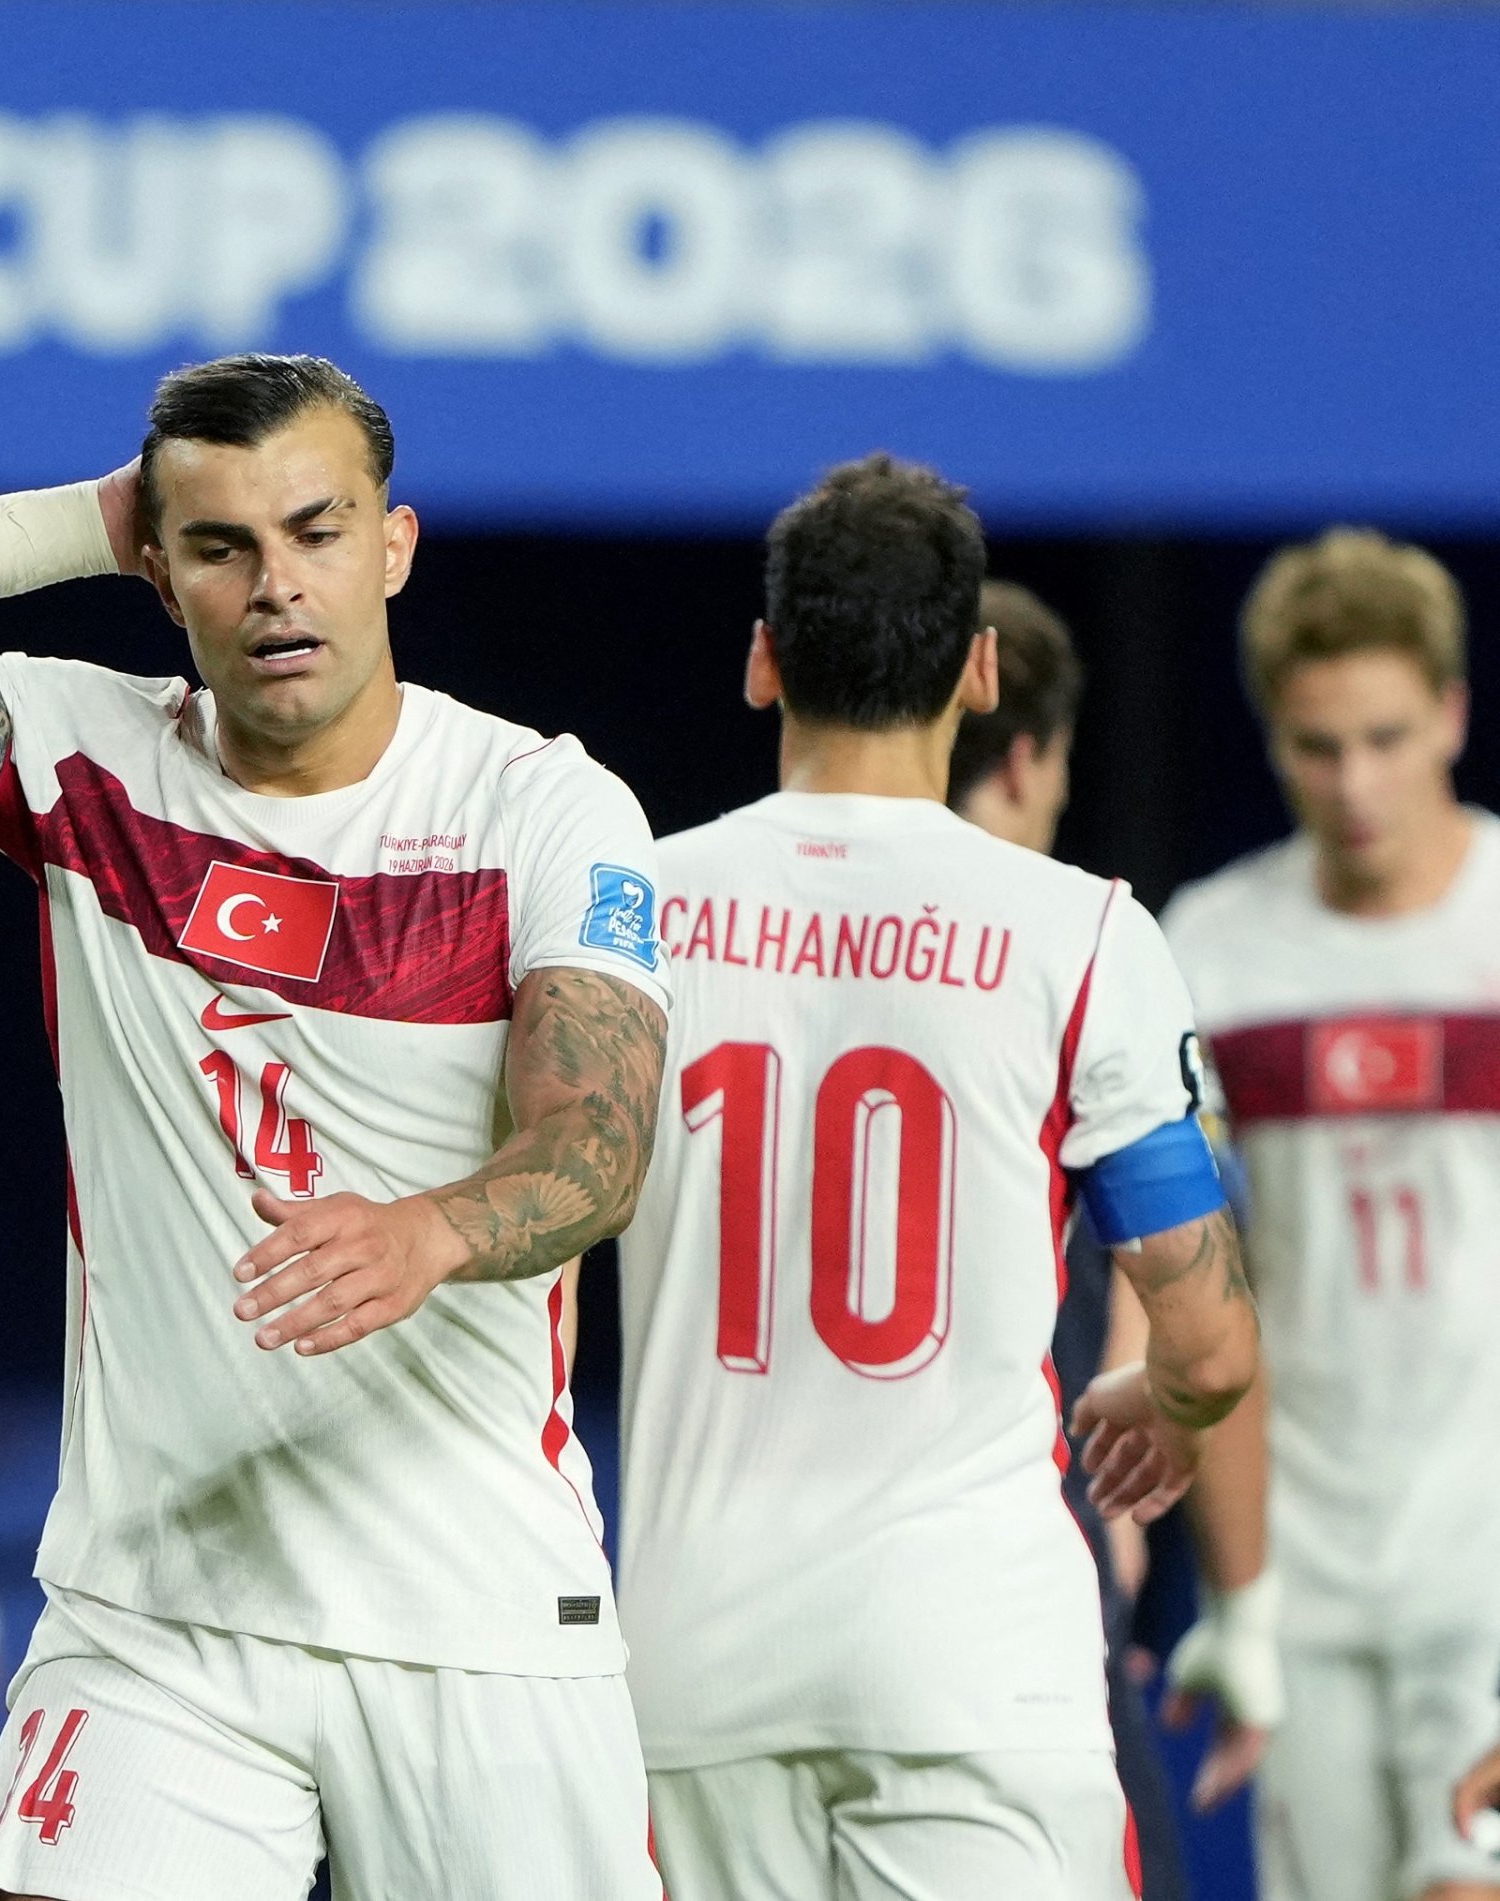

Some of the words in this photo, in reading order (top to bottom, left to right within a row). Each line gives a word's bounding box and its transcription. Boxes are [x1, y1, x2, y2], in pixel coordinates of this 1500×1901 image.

[351, 112, 1154, 375] 2026
[389, 859, 399, 873] 19
[434, 855, 454, 872] 2026
[198, 1048, 324, 1198] 14
[680, 1040, 958, 1382] 10
[1346, 1183, 1430, 1294] 11
